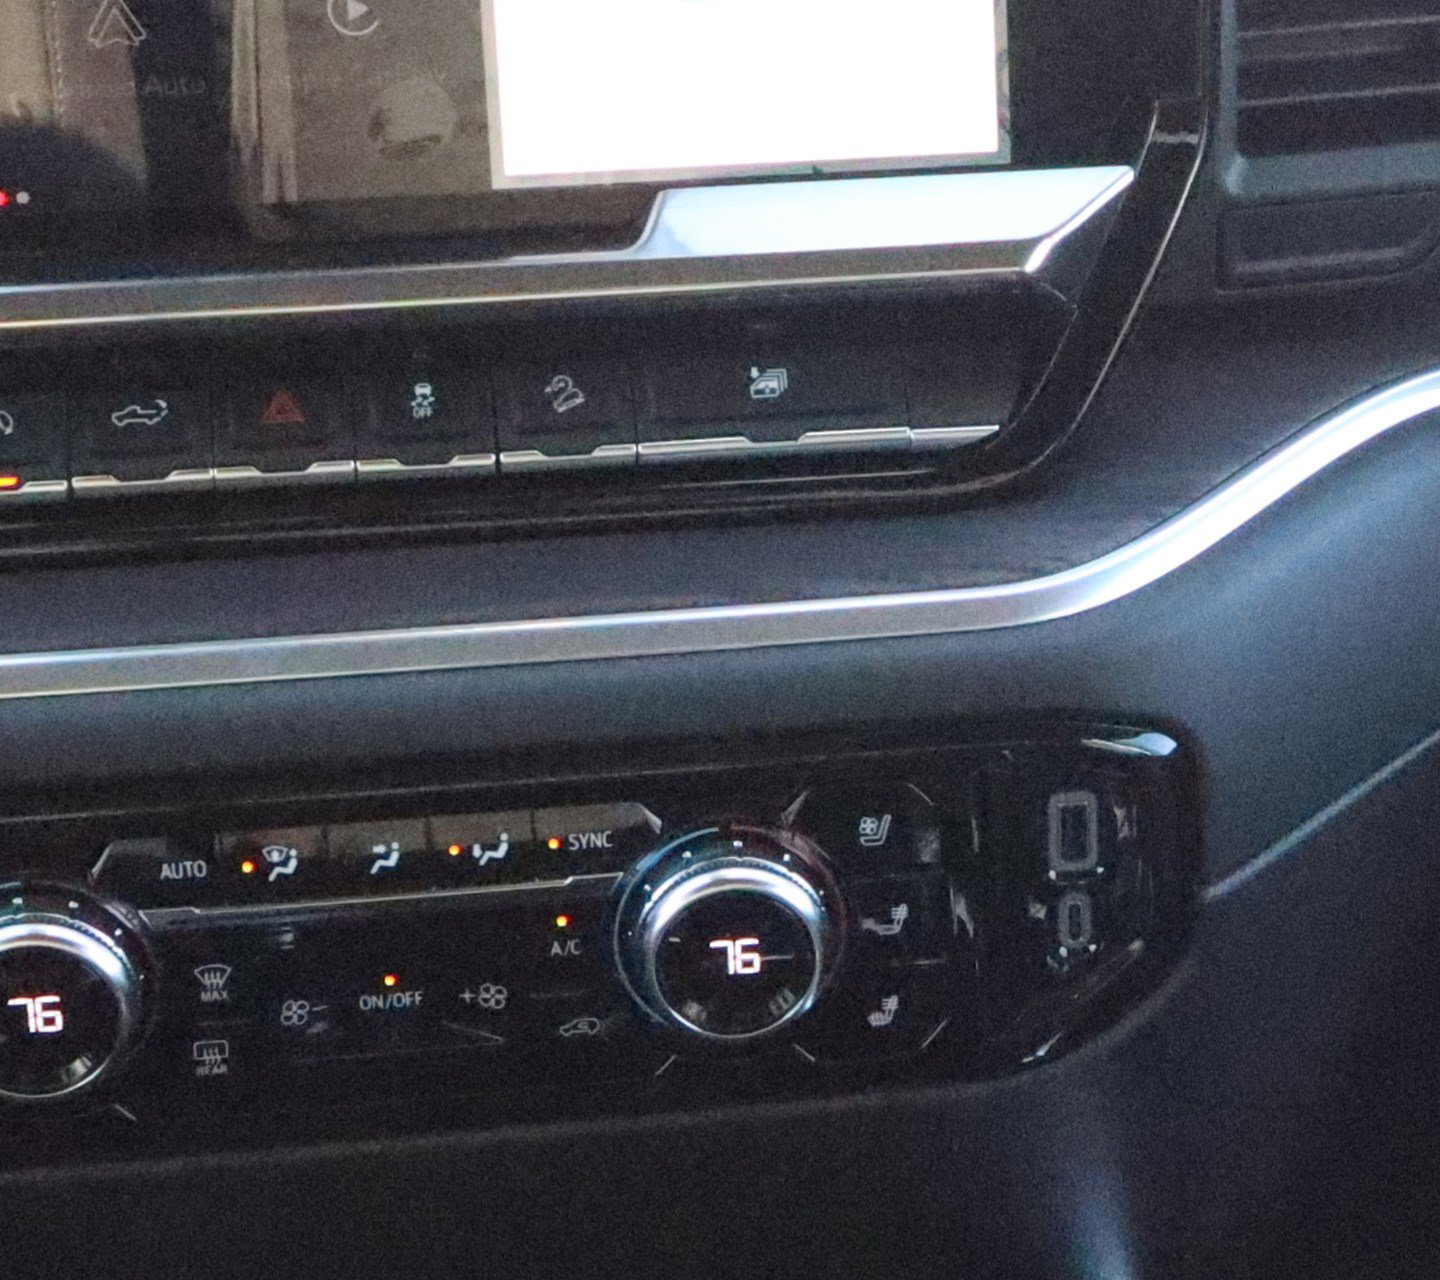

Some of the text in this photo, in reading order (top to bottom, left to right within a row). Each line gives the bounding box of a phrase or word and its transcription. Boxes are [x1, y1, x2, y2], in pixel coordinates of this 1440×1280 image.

[568, 830, 614, 851] SYNC
[161, 861, 207, 880] AUTO
[550, 939, 582, 957] A/C
[709, 937, 761, 975] 76
[359, 991, 424, 1011] ON/OFF
[7, 995, 64, 1034] 76
